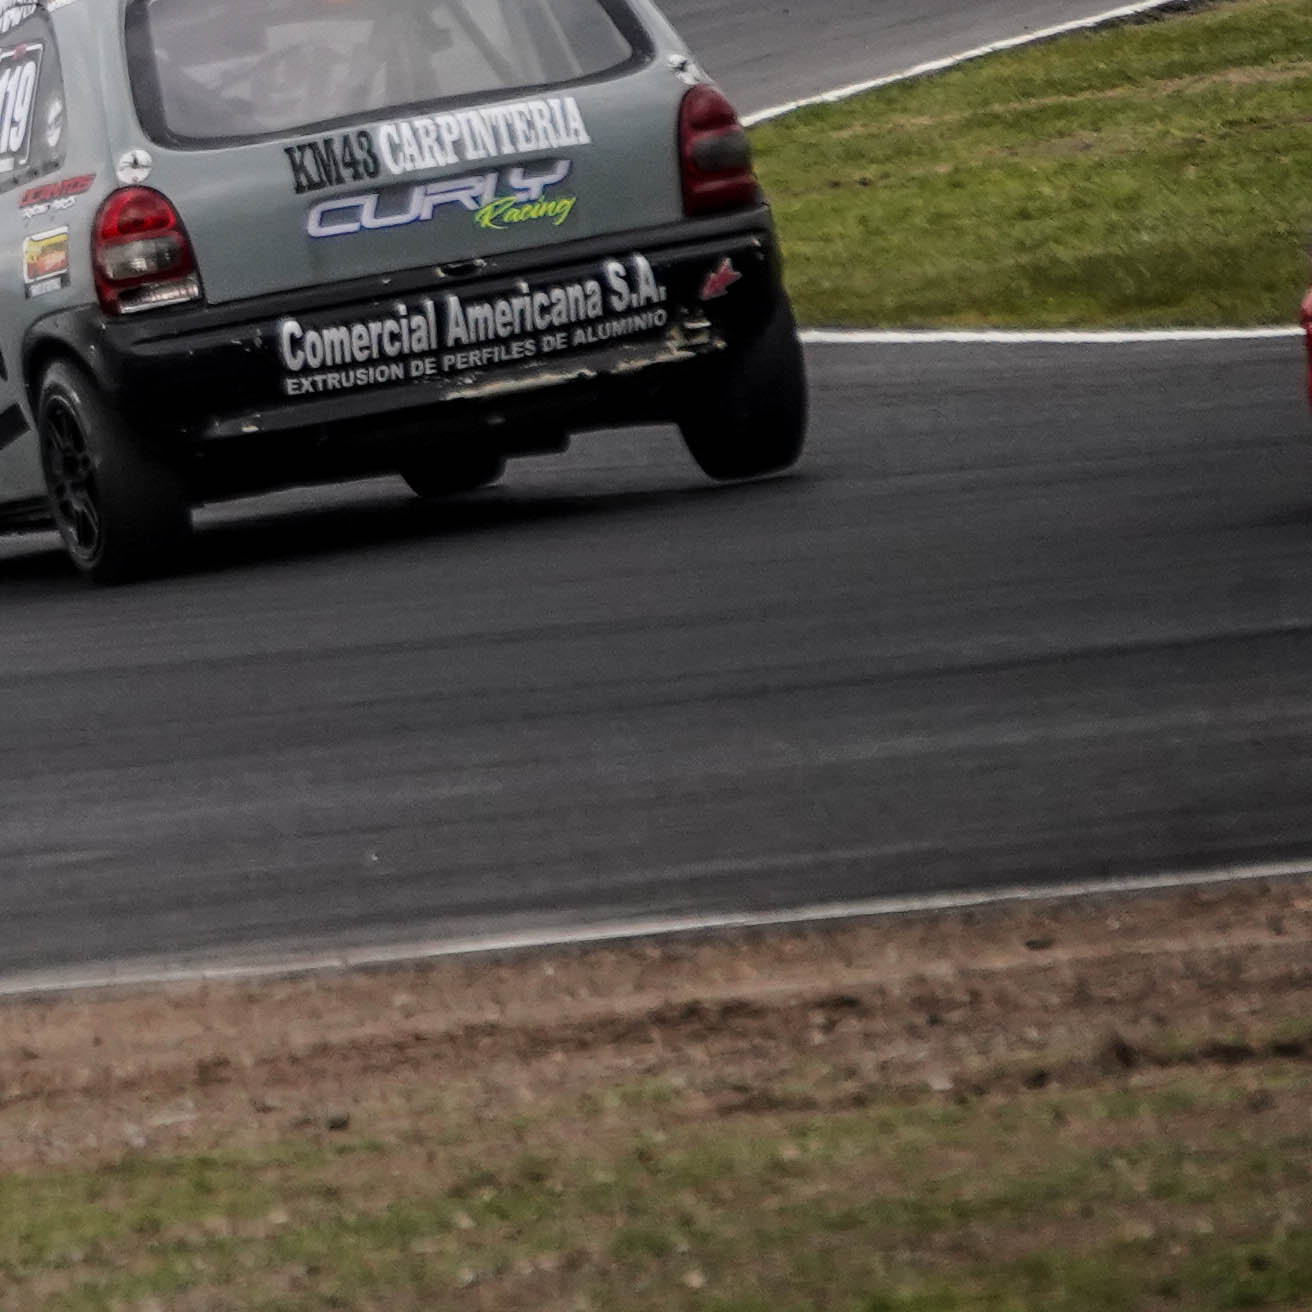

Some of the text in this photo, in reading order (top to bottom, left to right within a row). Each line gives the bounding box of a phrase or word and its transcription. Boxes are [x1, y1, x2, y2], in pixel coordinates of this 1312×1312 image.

[379, 96, 591, 175] CARPINTERIA
[306, 158, 573, 238] CURLY
[475, 194, 577, 230] Racing
[280, 252, 669, 373] Comercial Americana S.A.
[286, 309, 670, 396] EXTRUSION DE PERFILES DE ALUMINIO
